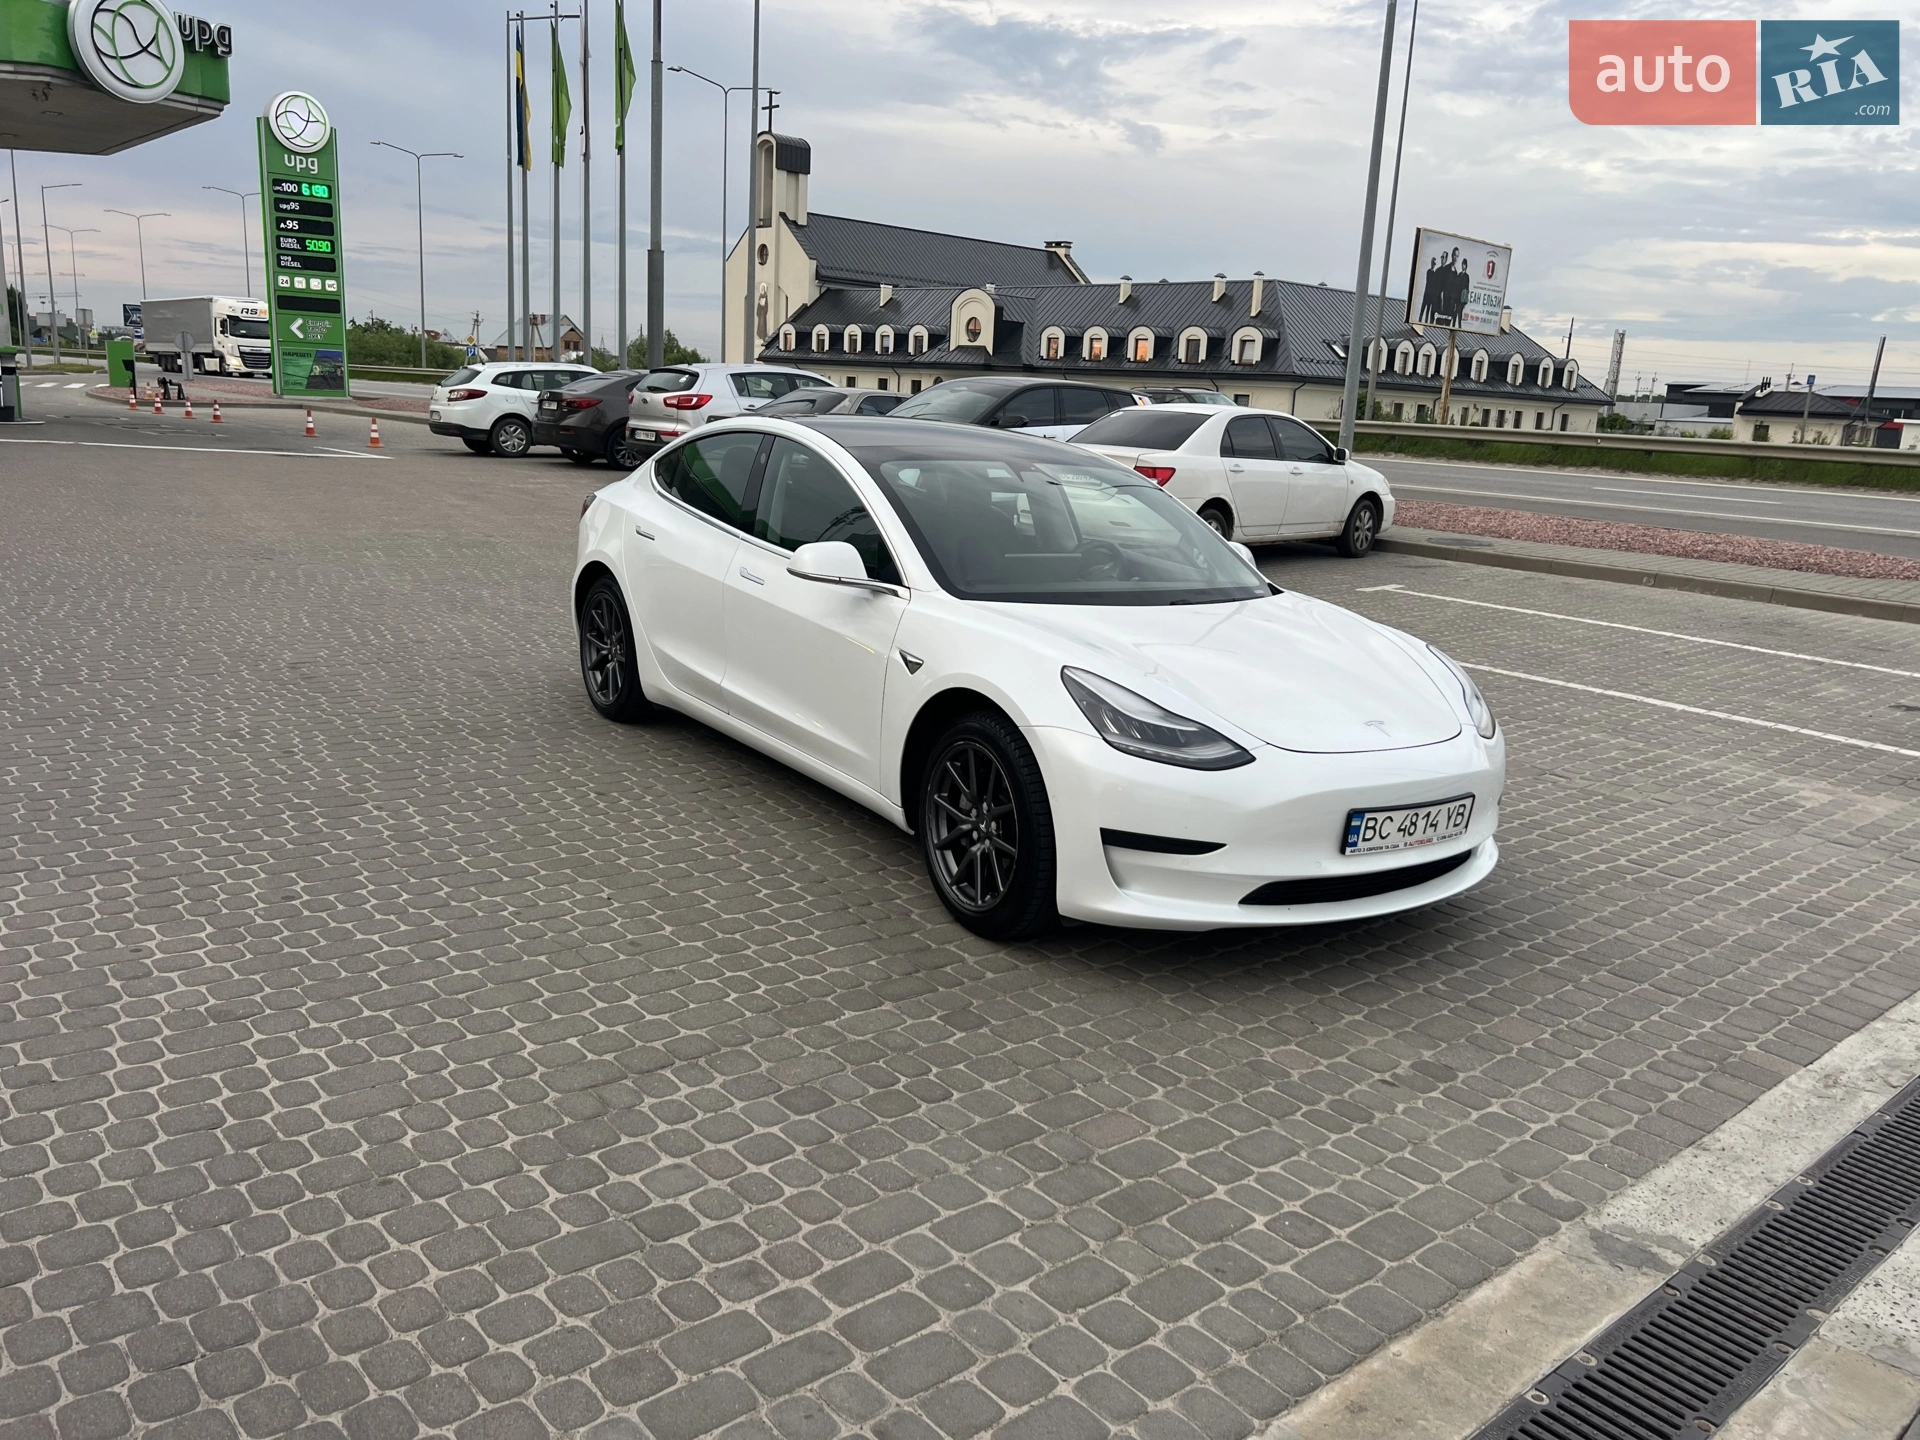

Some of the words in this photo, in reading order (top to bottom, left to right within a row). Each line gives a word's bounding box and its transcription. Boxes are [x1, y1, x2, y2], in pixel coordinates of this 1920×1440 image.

[173, 11, 232, 57] upg
[284, 154, 318, 174] upg
[280, 242, 301, 250] DIESEL
[280, 260, 302, 268] DIESEL
[1361, 815, 1394, 842] BC
[1397, 808, 1441, 838] 4814
[1445, 803, 1467, 830] YB
[1348, 834, 1358, 843] UA
